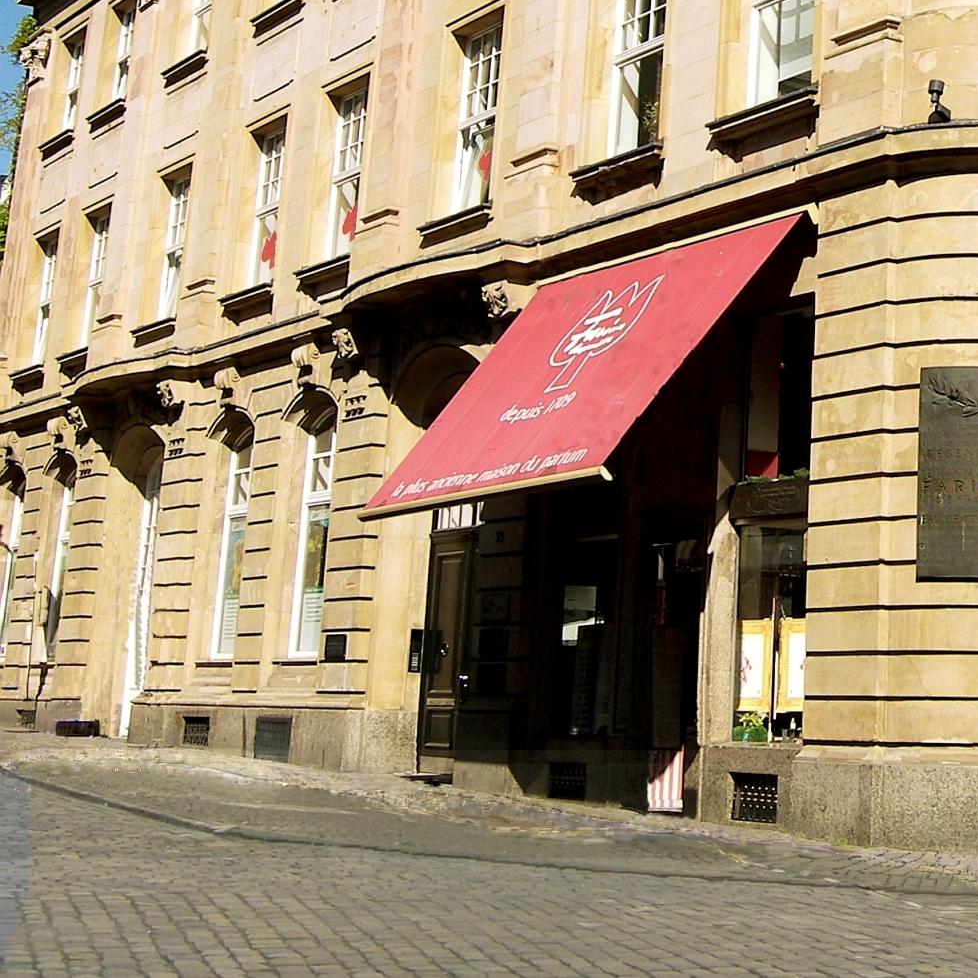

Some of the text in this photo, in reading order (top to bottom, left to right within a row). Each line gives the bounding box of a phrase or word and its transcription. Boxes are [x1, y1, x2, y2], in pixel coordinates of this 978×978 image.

[499, 392, 577, 425] depuis 1709
[401, 477, 426, 499] plus
[426, 472, 479, 493] ancienne
[476, 462, 521, 483] maison
[519, 454, 542, 472] du
[535, 446, 589, 475] parfum
